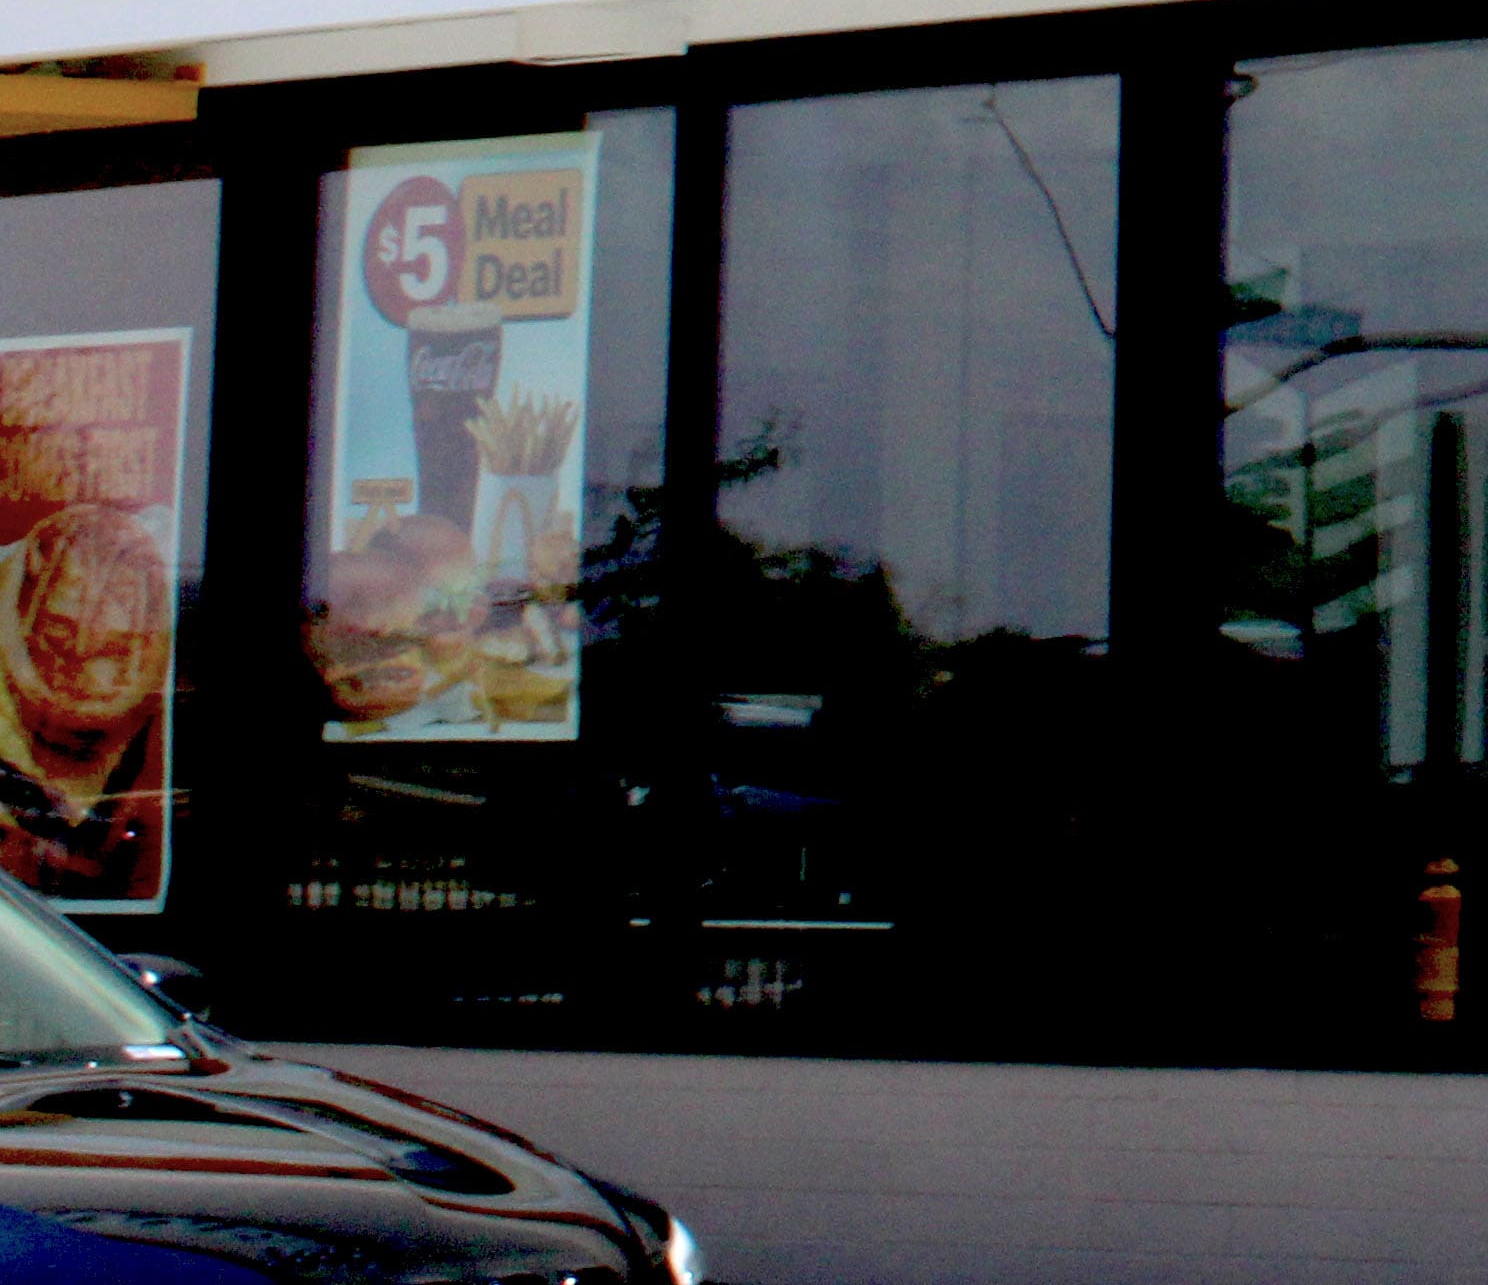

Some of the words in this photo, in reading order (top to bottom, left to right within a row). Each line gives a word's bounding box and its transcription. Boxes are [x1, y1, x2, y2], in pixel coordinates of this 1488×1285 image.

[474, 186, 569, 242] Meal
[377, 204, 449, 302] $5
[474, 246, 563, 301] Deal
